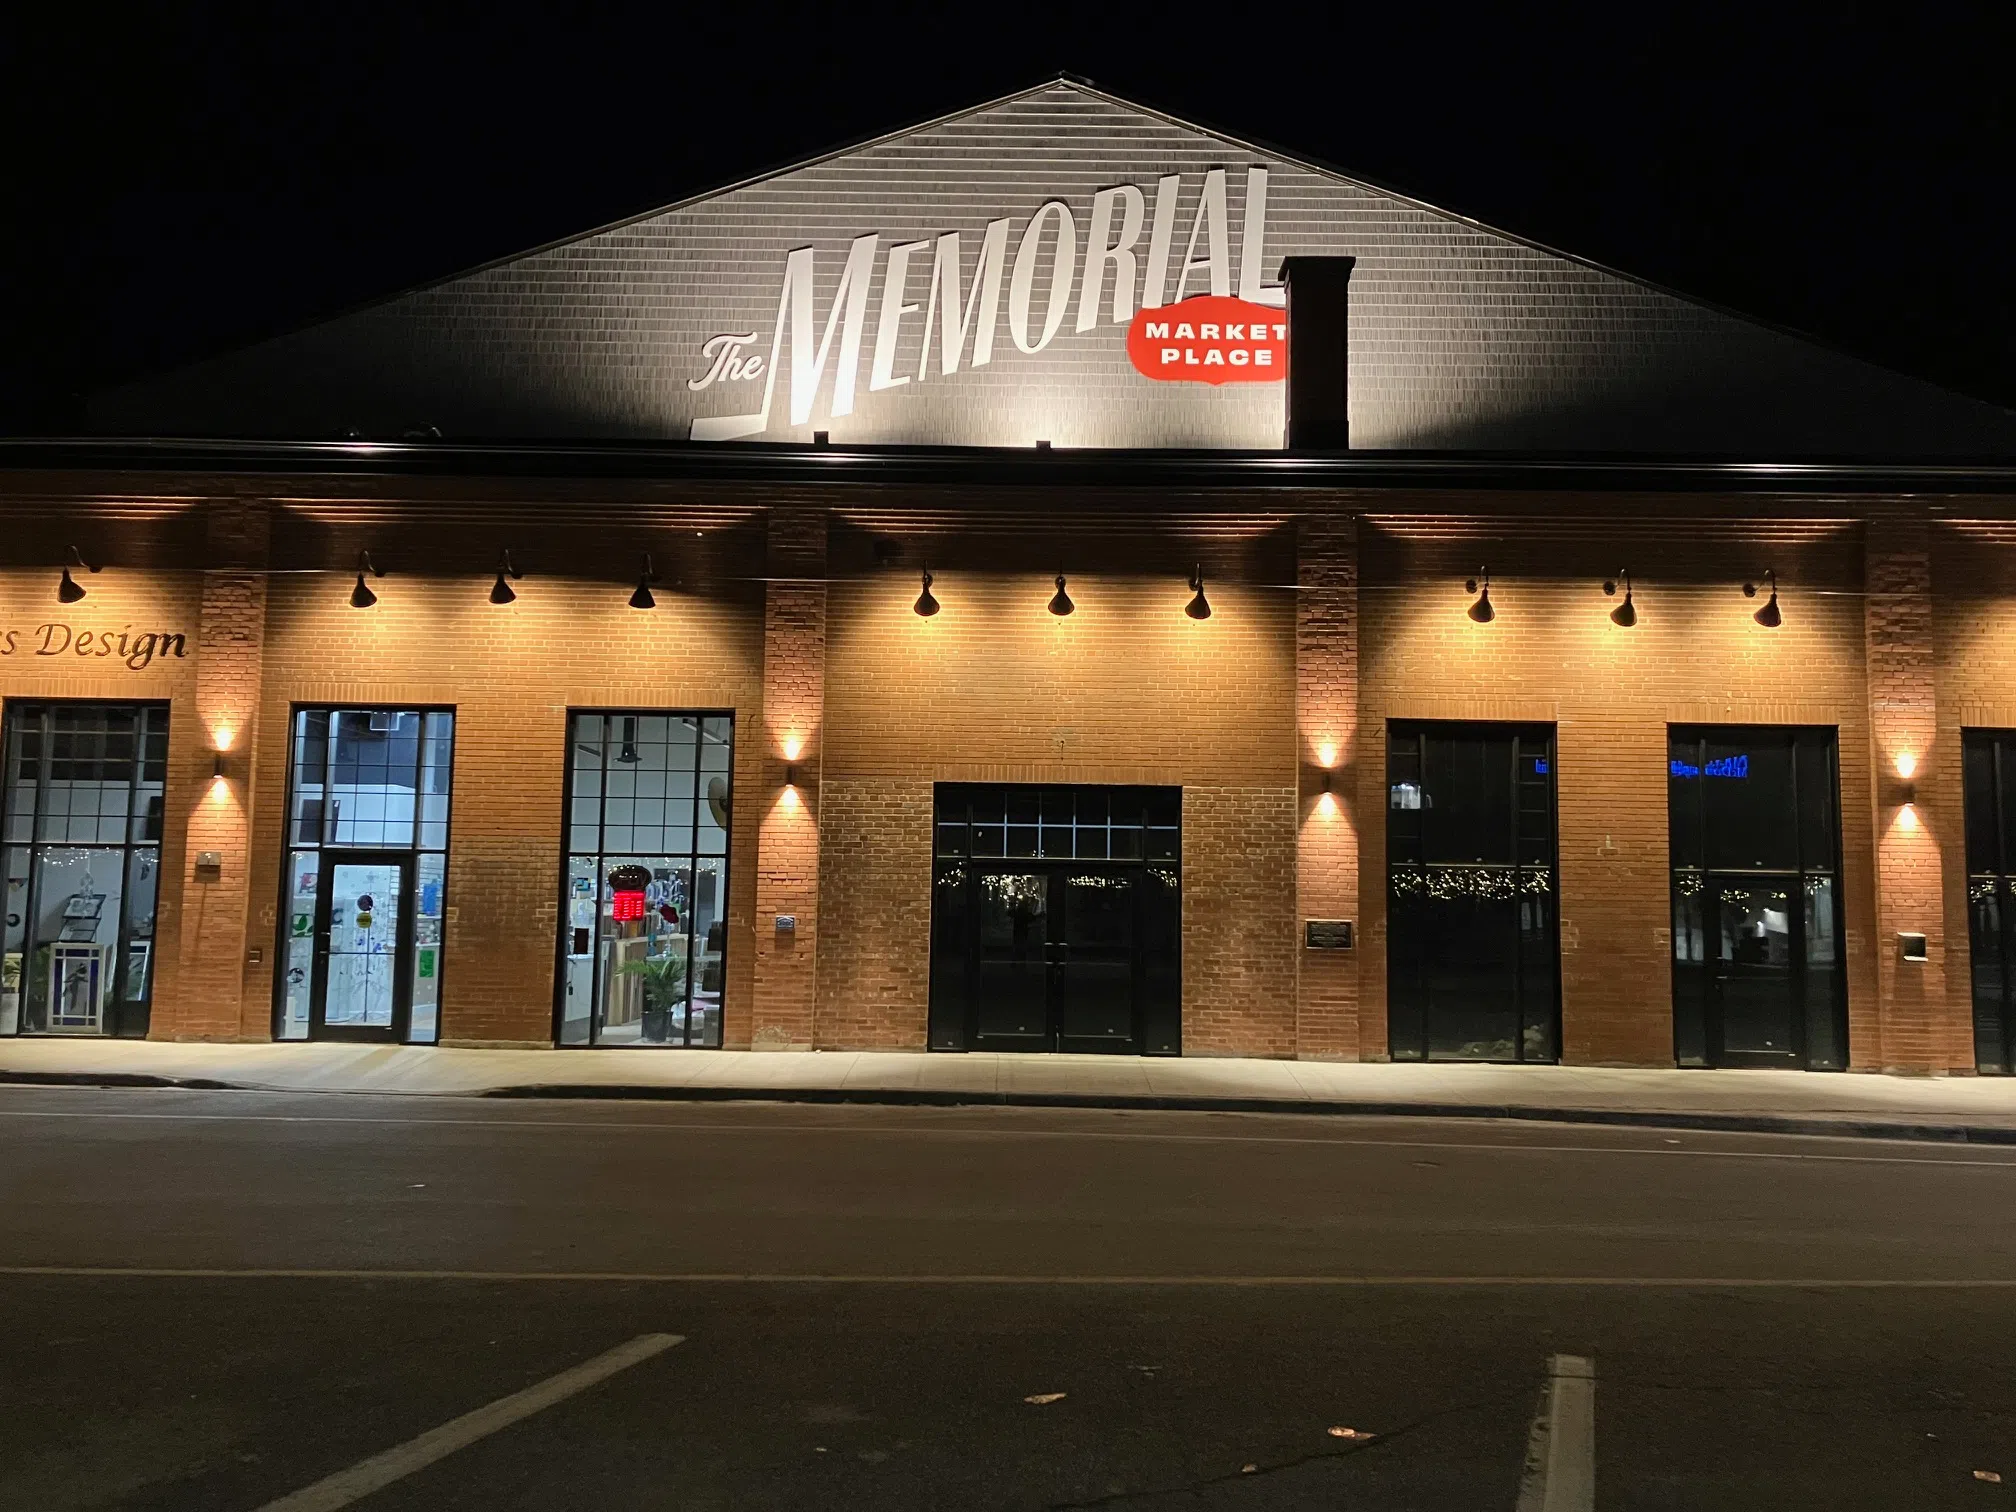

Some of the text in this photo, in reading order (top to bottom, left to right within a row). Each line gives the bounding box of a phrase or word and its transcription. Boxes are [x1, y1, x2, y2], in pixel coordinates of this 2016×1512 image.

[687, 166, 1287, 442] The MEMORIAL
[1145, 322, 1287, 341] MARKET
[1161, 348, 1272, 366] PLACE
[35, 623, 190, 671] Design
